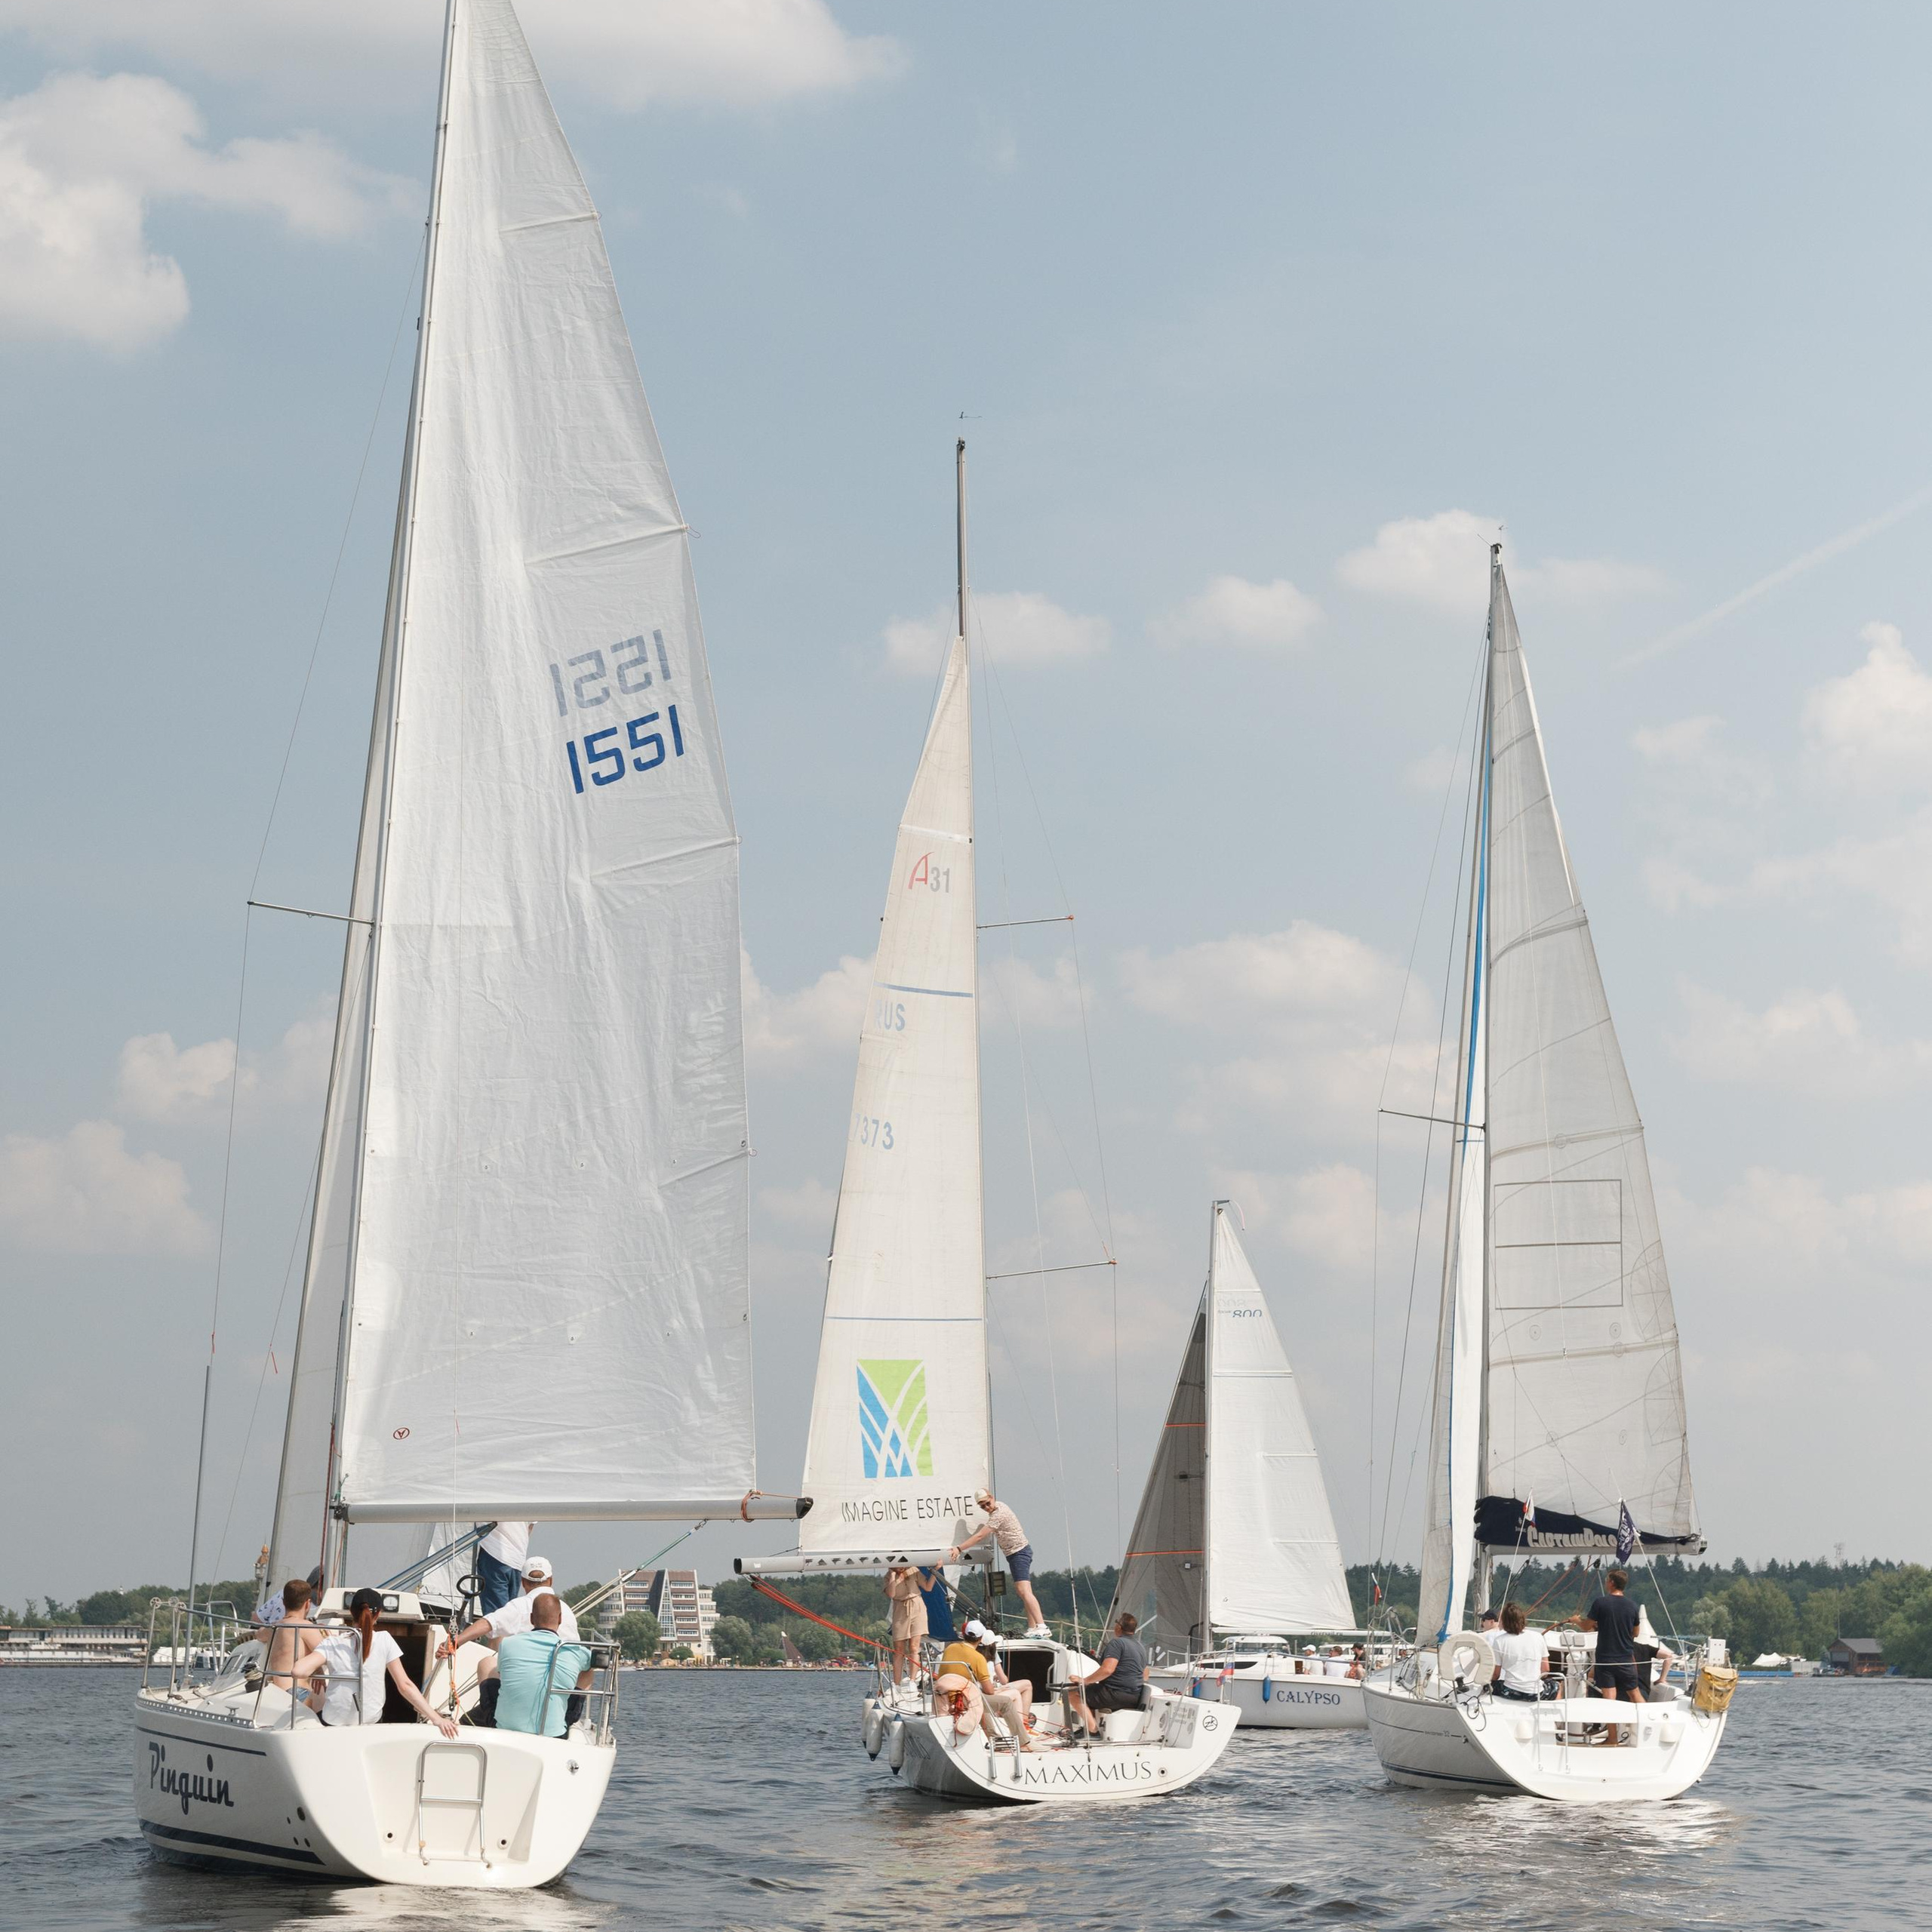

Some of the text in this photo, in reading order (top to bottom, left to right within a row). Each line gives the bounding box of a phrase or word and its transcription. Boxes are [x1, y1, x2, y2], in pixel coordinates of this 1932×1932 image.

[566, 705, 685, 794] 1551
[841, 1496, 974, 1522] IMAGINE ESTATE
[1277, 1690, 1340, 1705] CALYPSO
[149, 1741, 234, 1815] Pinguin
[1025, 1761, 1152, 1784] MAXIMUS
